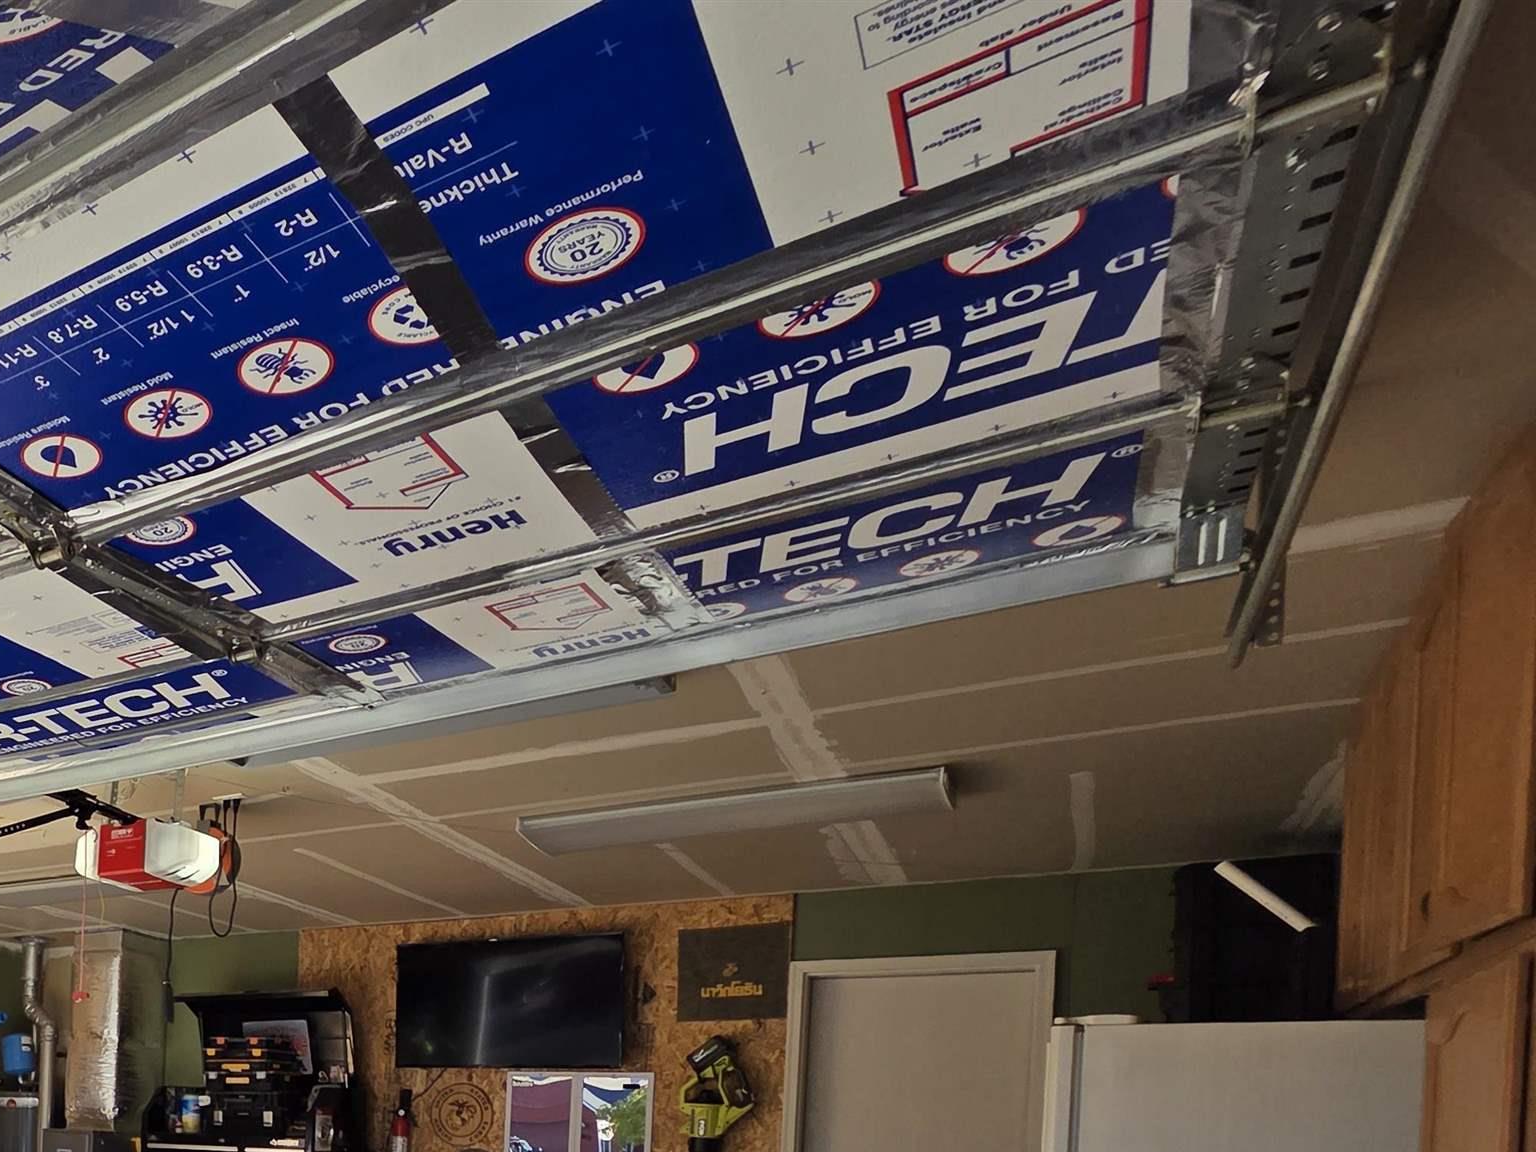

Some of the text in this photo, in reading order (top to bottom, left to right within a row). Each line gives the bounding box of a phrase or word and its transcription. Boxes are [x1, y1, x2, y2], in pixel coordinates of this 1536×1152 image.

[978, 4, 1072, 48] Under slab
[1037, 10, 1124, 51] Basement
[910, 61, 1003, 103] Crawlspace
[382, 113, 434, 144] UPC CODES
[922, 124, 982, 152] Exterior
[941, 117, 982, 137] walls
[393, 132, 472, 178] R-Valu
[418, 162, 518, 214] Thickne
[275, 209, 319, 237] R-2
[479, 169, 643, 246] Performance Warranty
[558, 230, 607, 254] YEARS
[570, 243, 605, 264] 20
[187, 245, 244, 279] R-3.9
[115, 280, 168, 312] R-5.9
[342, 274, 400, 304] ecyclable
[964, 271, 1082, 320] FOR
[47, 315, 97, 344] R-7.8
[209, 318, 300, 360] Insect Resistant
[660, 316, 943, 420] EFFICIENCY
[101, 371, 174, 406] Mold Resistant
[291, 392, 374, 431] FOR
[104, 423, 288, 499] EFFICIENCY
[152, 526, 173, 537] 20
[384, 509, 527, 557] Henry
[772, 560, 843, 584] FOR
[855, 500, 1091, 561] EFFICIENCY
[531, 628, 651, 658] Henry
[335, 652, 410, 672] ENGIN
[99, 721, 136, 735] FOR
[139, 697, 249, 726] EFFICIENCY
